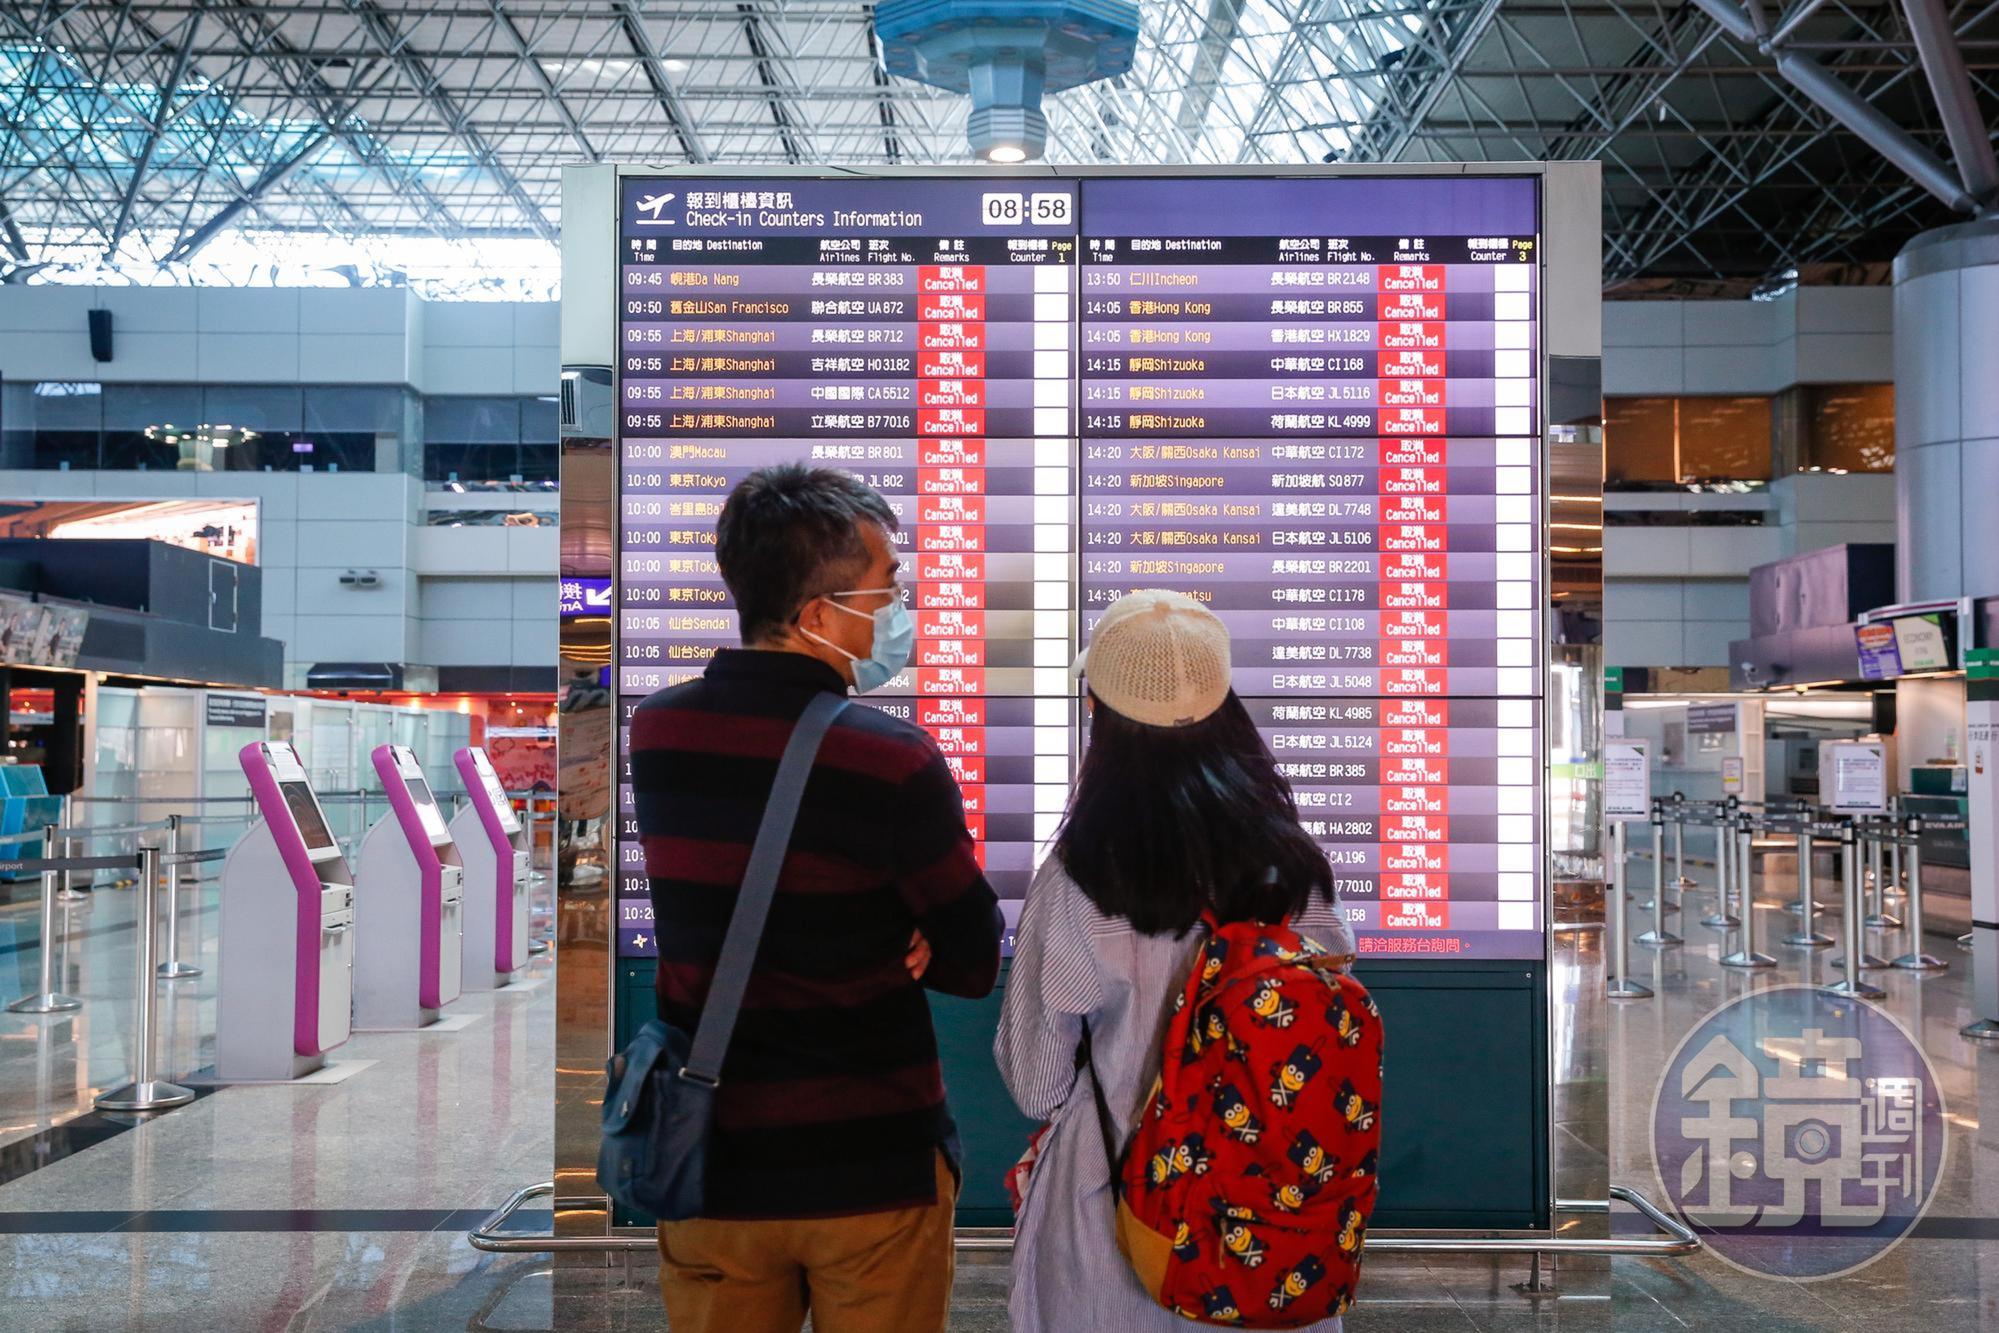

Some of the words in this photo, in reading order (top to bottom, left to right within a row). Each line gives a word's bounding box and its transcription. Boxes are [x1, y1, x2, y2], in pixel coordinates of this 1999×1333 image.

[988, 199, 1066, 218] 08:58
[687, 211, 751, 226] Check-in
[760, 211, 824, 226] Counters
[834, 211, 921, 226] Information
[707, 240, 762, 250] Destination
[1052, 242, 1071, 251] Page
[1166, 240, 1221, 250] Destination
[1513, 240, 1532, 252] Page
[635, 252, 654, 261] Time
[820, 252, 860, 262] Airlines
[868, 253, 897, 263] Flight
[902, 253, 915, 261] No.
[934, 253, 969, 262] Remarks
[1011, 253, 1046, 261] Counter
[1059, 253, 1065, 262] 1
[1093, 252, 1113, 261] Time
[1279, 252, 1319, 261] Airlines
[1326, 252, 1359, 264] Flight
[1361, 252, 1374, 261] No.
[1394, 252, 1429, 261] Remarks
[1471, 252, 1506, 260] Counter
[1519, 252, 1526, 261] 3
[629, 273, 662, 285] 09:45
[713, 273, 740, 287] Nang
[1088, 273, 1120, 285] 13:50
[924, 279, 978, 291] Cancelled
[1385, 279, 1438, 291] Cancelled
[628, 301, 661, 313] 09:50
[733, 302, 788, 313] Francisco
[1088, 302, 1120, 313] 14:05
[1185, 302, 1210, 314] Kong
[924, 308, 978, 319] Cancelled
[628, 330, 661, 341] 09:55
[1088, 330, 1120, 342] 14:05
[1184, 330, 1212, 343] Kong
[628, 358, 661, 370] 09:55
[1088, 359, 1120, 371] 14:15
[628, 387, 661, 398] 09:55
[1088, 387, 1120, 399] 14:15
[1386, 393, 1439, 405] Cancelled
[628, 415, 661, 427] 09:55
[1088, 416, 1120, 428] 14:15
[924, 422, 978, 433] Cancelled
[628, 446, 661, 458] 10:00
[1088, 447, 1121, 458] 14:20
[1224, 447, 1259, 458] Kansai
[628, 474, 661, 486] 10:00
[1088, 475, 1121, 487] 14:20
[628, 503, 660, 515] 10:00
[1088, 504, 1121, 515] 14:20
[924, 510, 978, 521] Cancelled
[1386, 510, 1439, 521] Cancelled
[627, 532, 660, 543] 10:00
[627, 589, 660, 600] 10:00
[1088, 590, 1122, 603] 14:30
[625, 617, 659, 630] 10:05
[924, 624, 978, 635] Cancelled
[1387, 624, 1440, 636] Cancelled
[626, 675, 659, 686] 10:05
[924, 681, 978, 693] Cancelled
[1387, 742, 1440, 754] Cancelled
[1387, 829, 1440, 840] Cancelled
[1388, 915, 1441, 927] Cancelled
